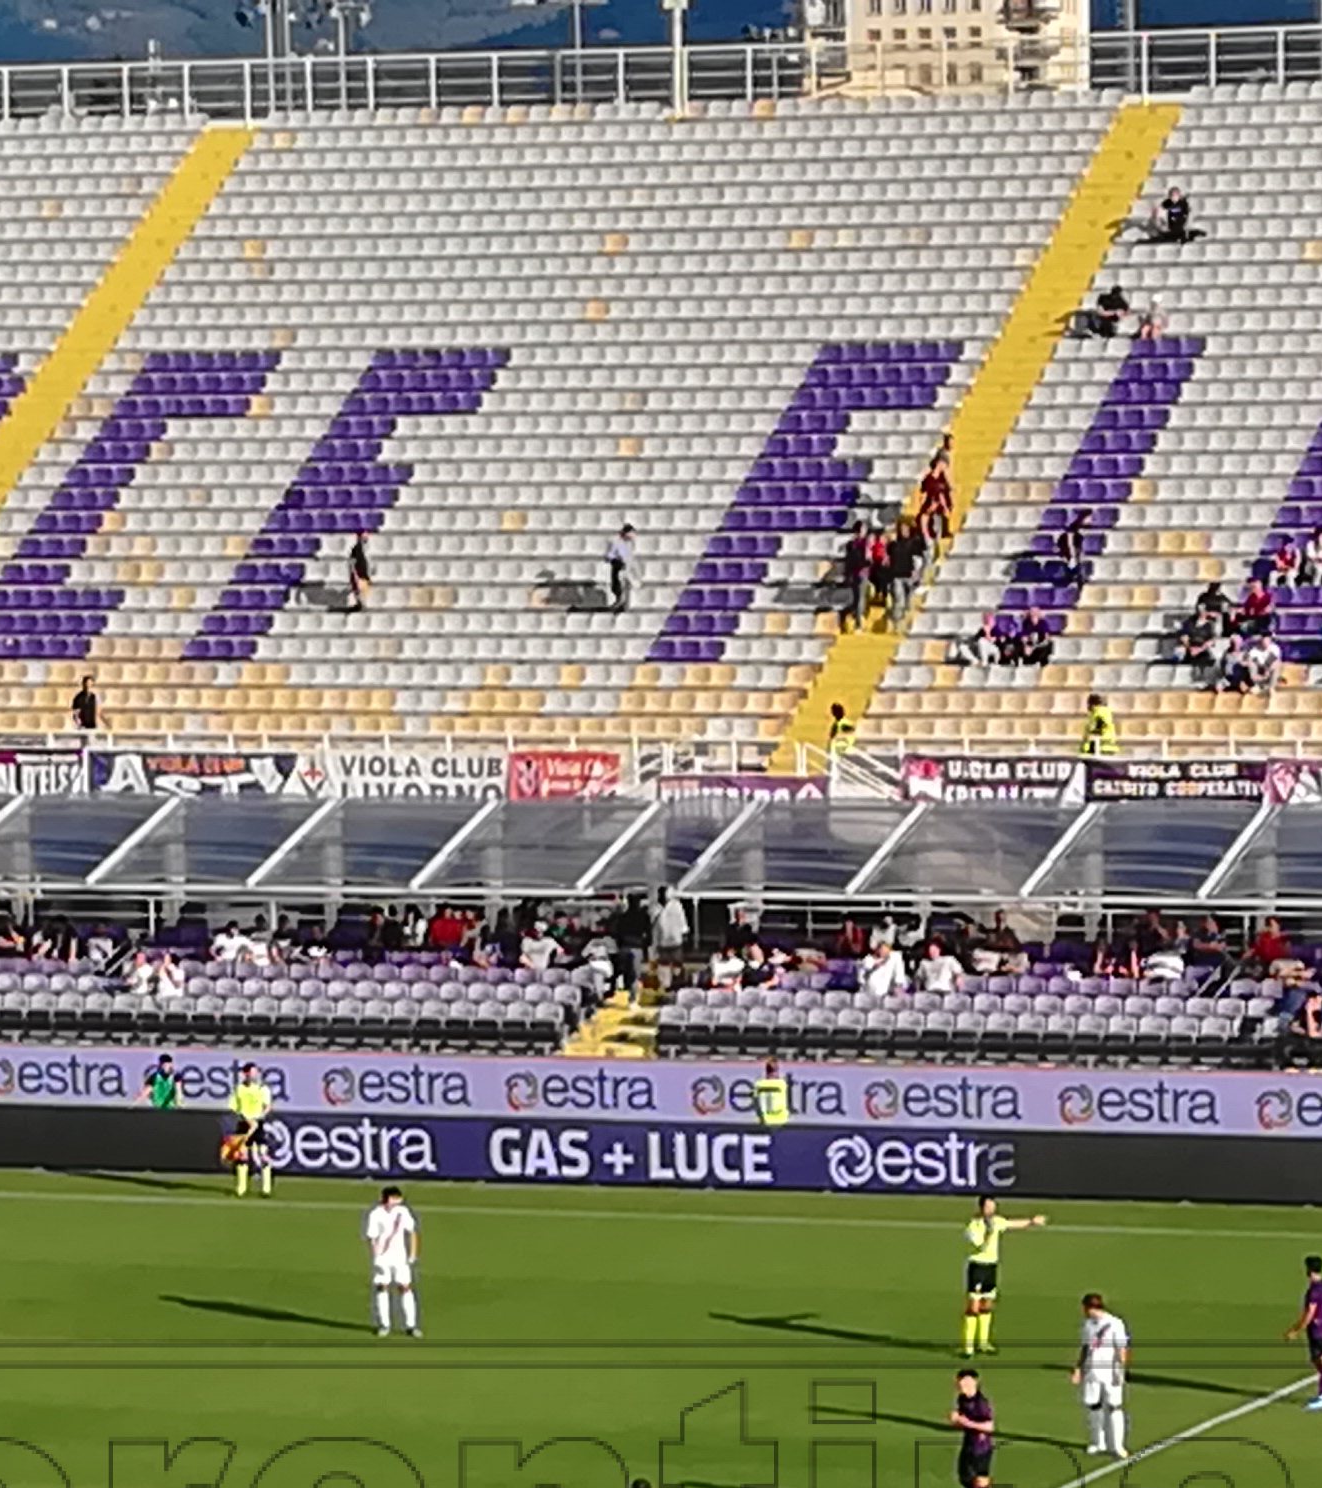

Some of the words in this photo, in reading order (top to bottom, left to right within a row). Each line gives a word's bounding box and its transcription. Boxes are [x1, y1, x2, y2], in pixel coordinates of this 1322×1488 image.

[340, 756, 421, 777] VIOLA
[431, 757, 502, 778] CLUB
[17, 1054, 126, 1098] estra
[180, 1060, 290, 1103] esta
[358, 1063, 470, 1108] estra
[541, 1067, 656, 1111] estra
[727, 1072, 846, 1116] etra
[902, 1077, 1022, 1121] estra
[1097, 1082, 1220, 1127] estra
[292, 1117, 438, 1173] estra
[488, 1127, 588, 1178] GAS
[648, 1131, 773, 1183] LUCE
[876, 1130, 1017, 1188] estra
